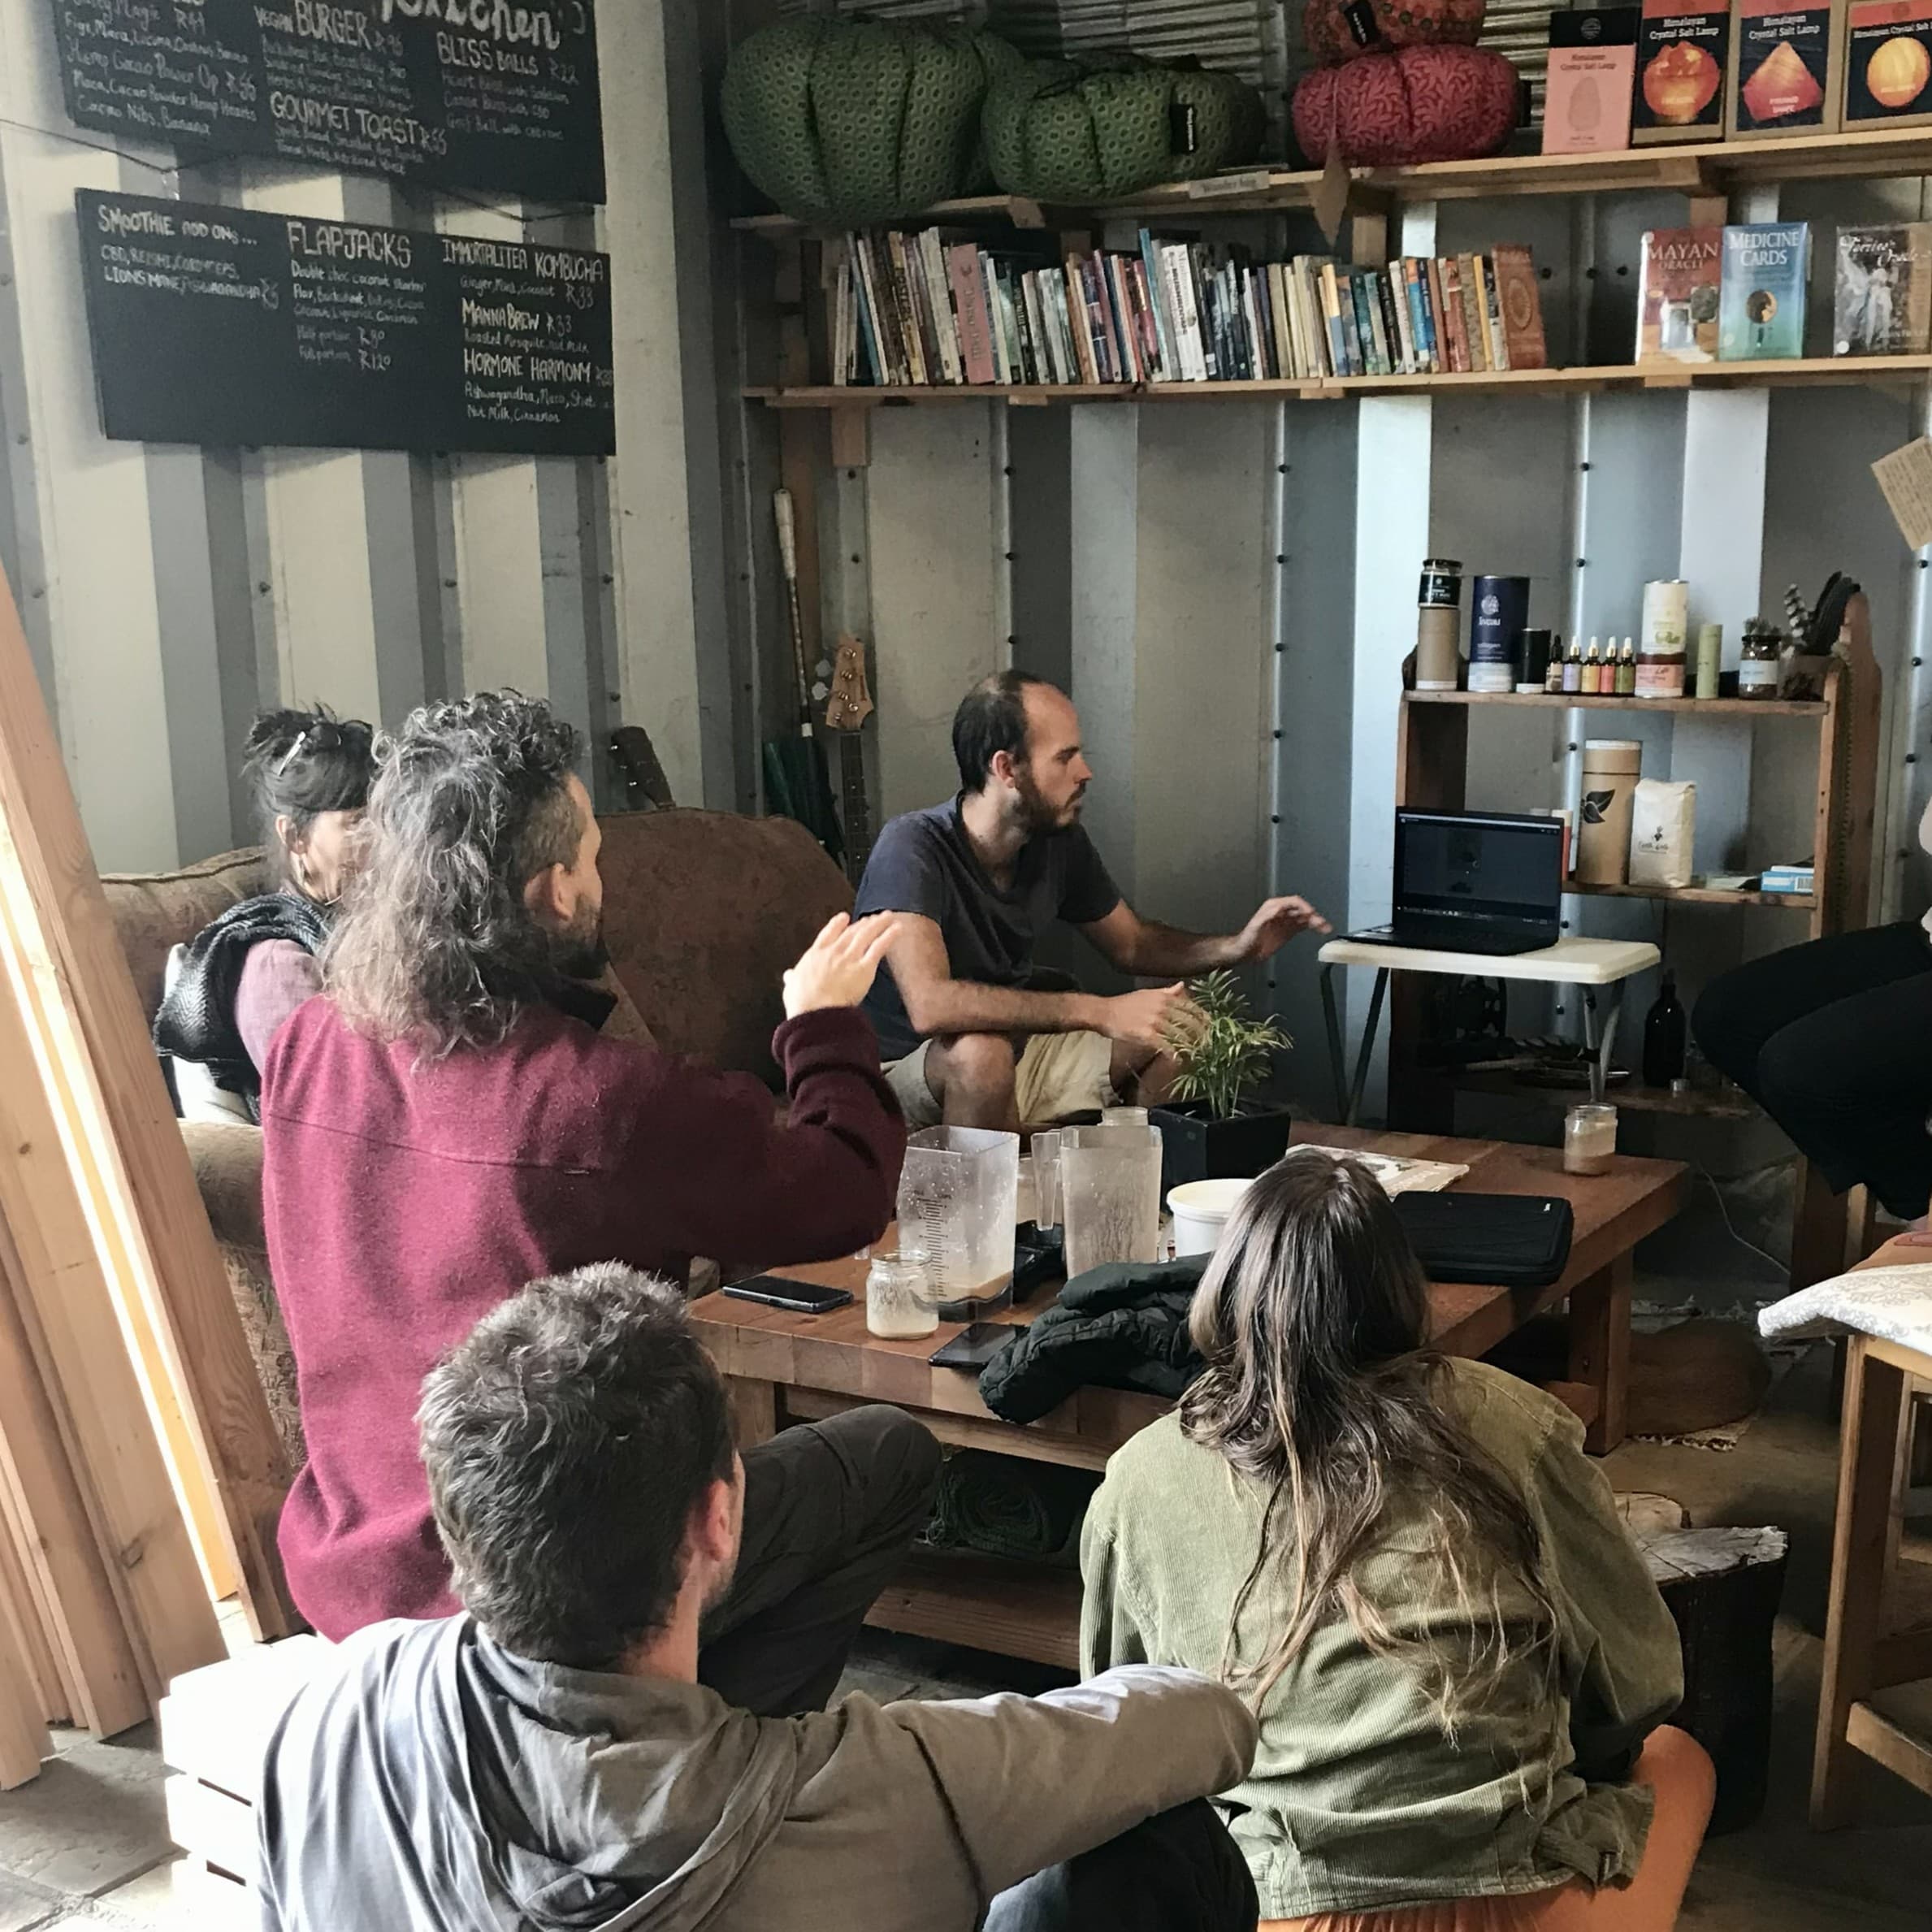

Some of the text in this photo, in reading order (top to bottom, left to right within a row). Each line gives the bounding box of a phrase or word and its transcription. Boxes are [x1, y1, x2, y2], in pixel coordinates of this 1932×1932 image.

[295, 0, 372, 50] BURGER
[1679, 27, 1694, 38] Salt
[1778, 26, 1796, 37] Salt
[1796, 24, 1821, 35] Lamp
[436, 30, 494, 71] BLISS
[496, 50, 539, 76] BALLS
[270, 90, 349, 131] GOURMET
[355, 108, 418, 145] TOAST
[98, 204, 176, 238] SMOOTHIE
[287, 220, 412, 269] FLAPJACKS
[1648, 241, 1719, 261] MAYAN
[1728, 231, 1800, 250] MEDICINE
[535, 252, 604, 283] KOMBUCHA
[1740, 249, 1788, 267] CARDS
[103, 266, 147, 285] LIONS
[463, 347, 524, 379] HORMONE
[531, 356, 591, 383] HARMONY
